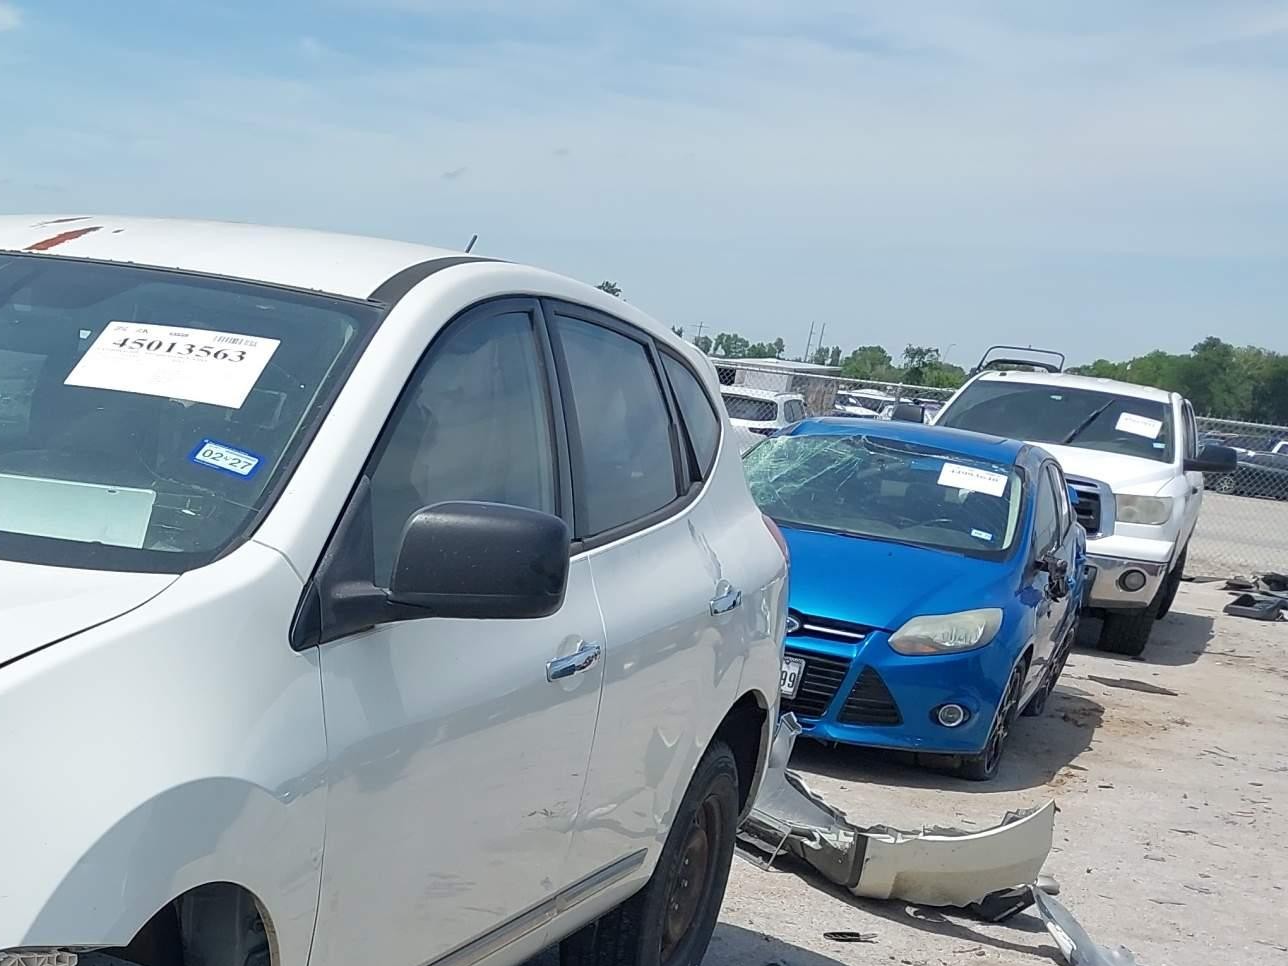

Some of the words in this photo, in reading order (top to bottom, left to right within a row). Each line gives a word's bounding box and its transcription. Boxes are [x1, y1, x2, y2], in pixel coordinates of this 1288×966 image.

[111, 336, 248, 364] 45013563
[201, 448, 225, 462] 02
[227, 457, 253, 470] 27
